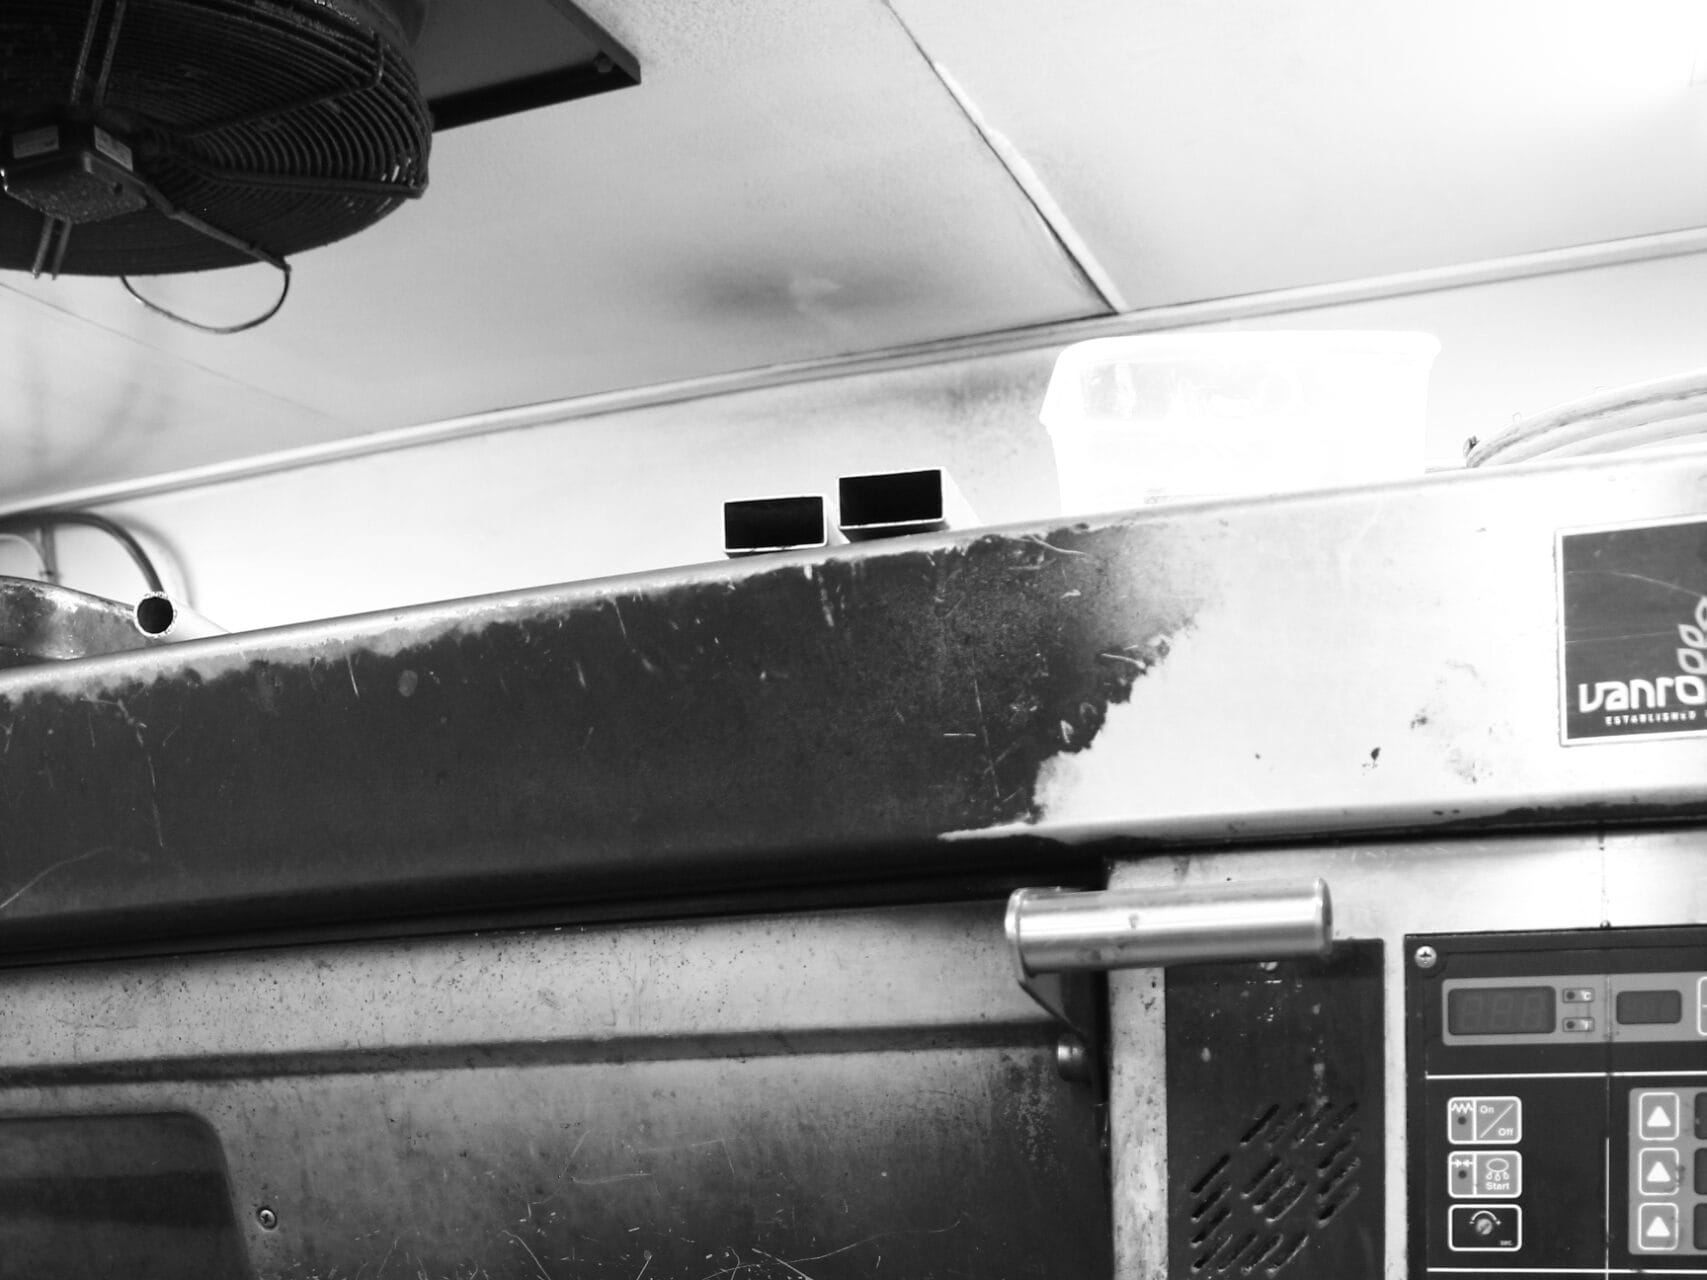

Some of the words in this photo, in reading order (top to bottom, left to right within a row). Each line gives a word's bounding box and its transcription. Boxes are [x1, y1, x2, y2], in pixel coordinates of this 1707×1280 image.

[1479, 1104, 1495, 1114] On
[1498, 1126, 1514, 1137] Off
[1485, 1180, 1511, 1191] Start
